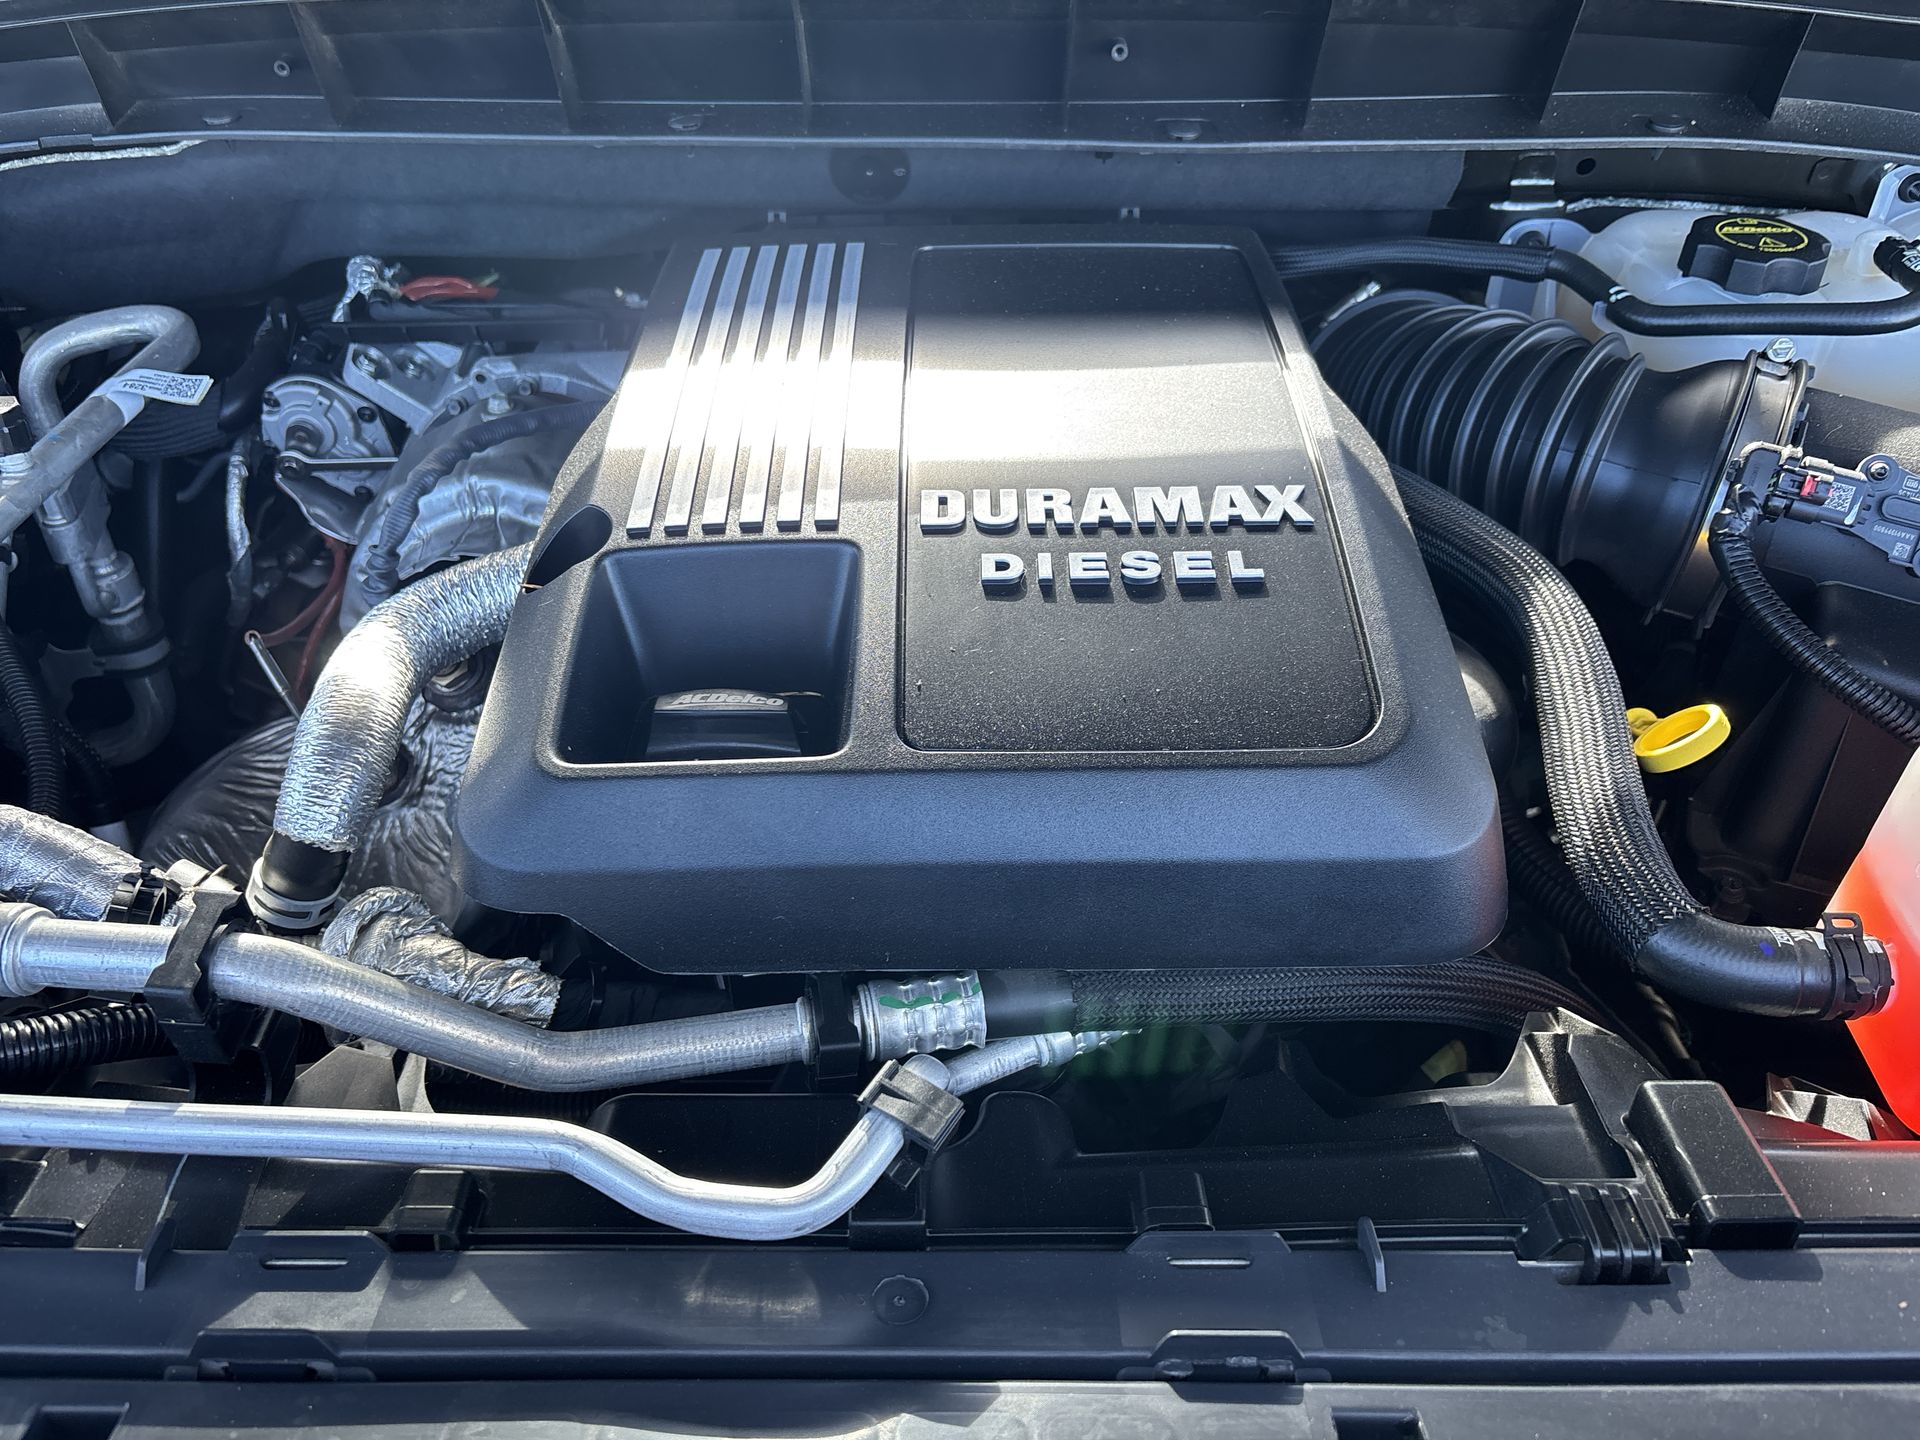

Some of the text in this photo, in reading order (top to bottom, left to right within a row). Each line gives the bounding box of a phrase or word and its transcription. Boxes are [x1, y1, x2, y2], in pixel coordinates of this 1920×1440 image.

[1720, 226, 1794, 234] ACDelco
[919, 484, 1315, 531] DURAMAX
[980, 550, 1265, 585] DIESEL
[671, 692, 785, 707] ACDelco
